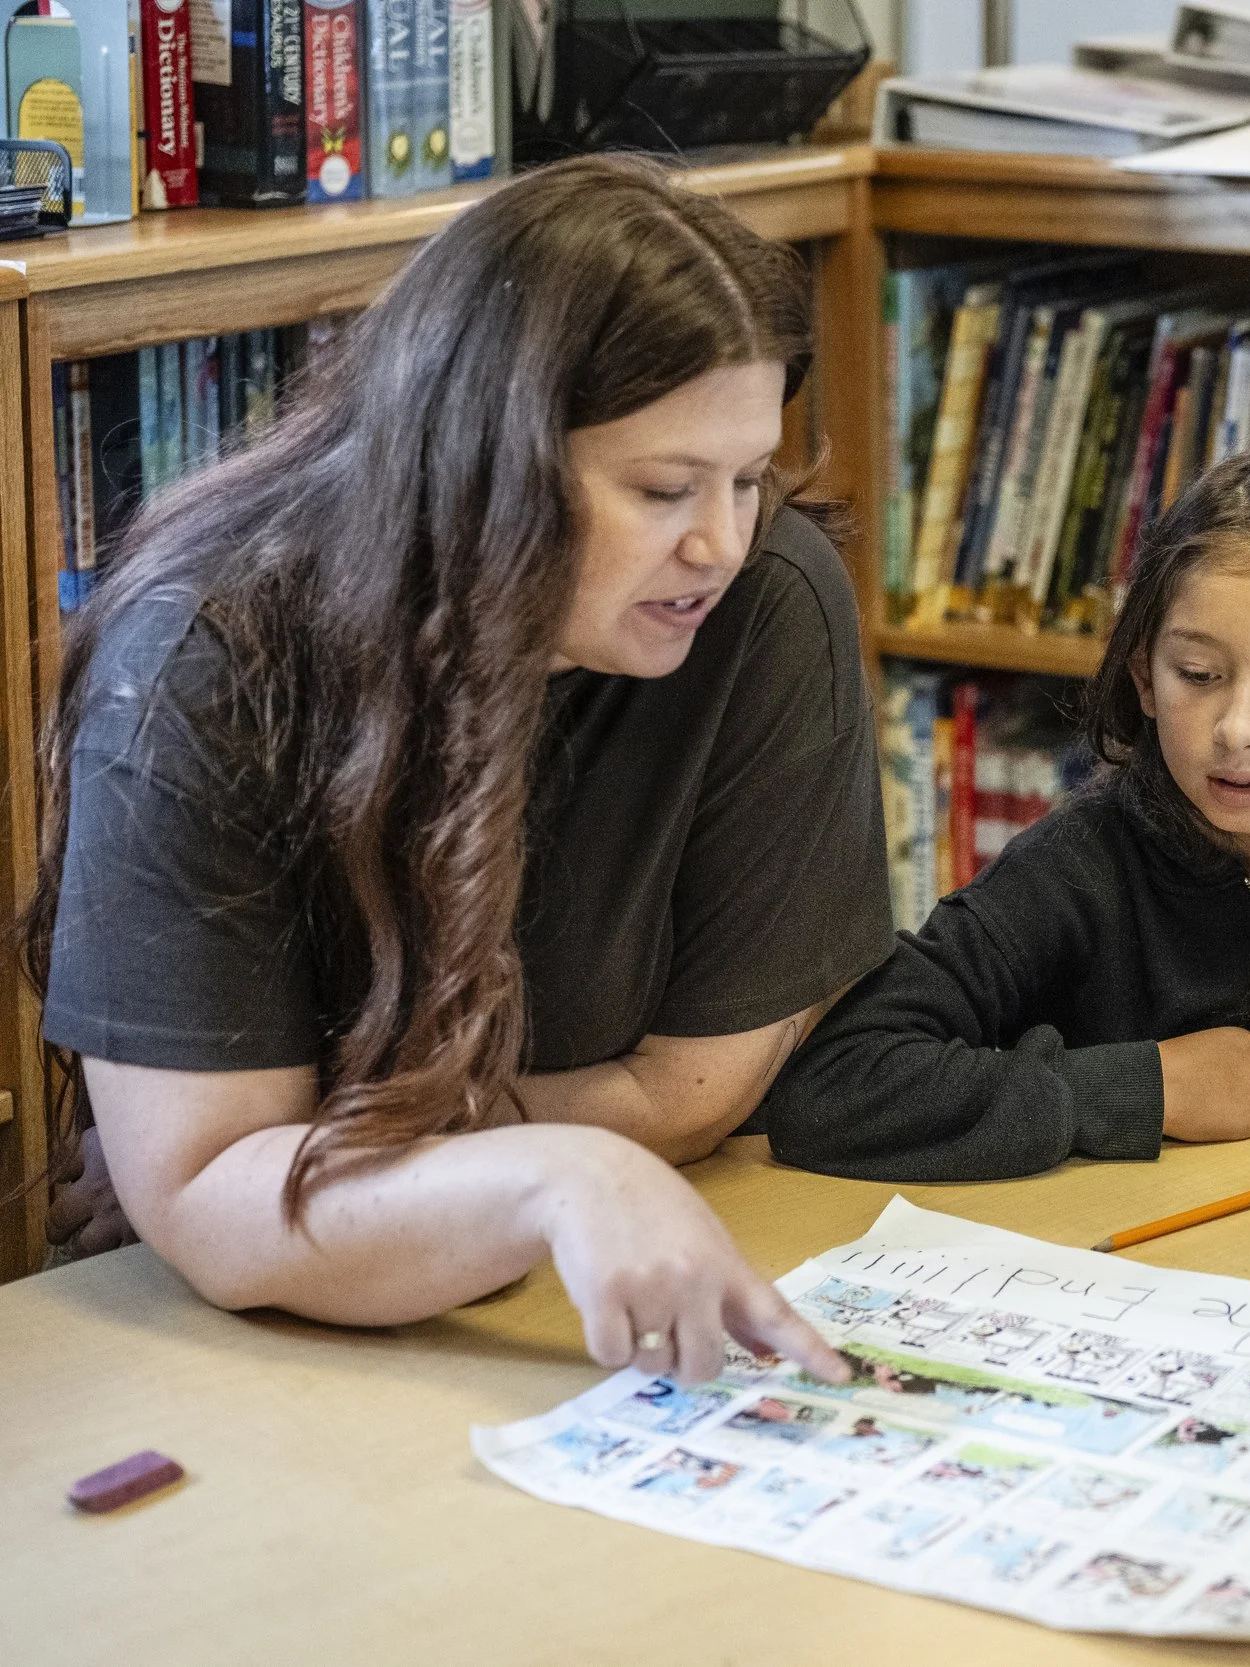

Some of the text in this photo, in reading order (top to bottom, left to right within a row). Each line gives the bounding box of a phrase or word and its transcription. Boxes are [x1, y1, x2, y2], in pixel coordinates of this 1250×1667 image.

[157, 18, 177, 156] Dictionary
[283, 34, 301, 106] CENTURY
[309, 14, 331, 127] Dictionary
[332, 14, 354, 120] Children's
